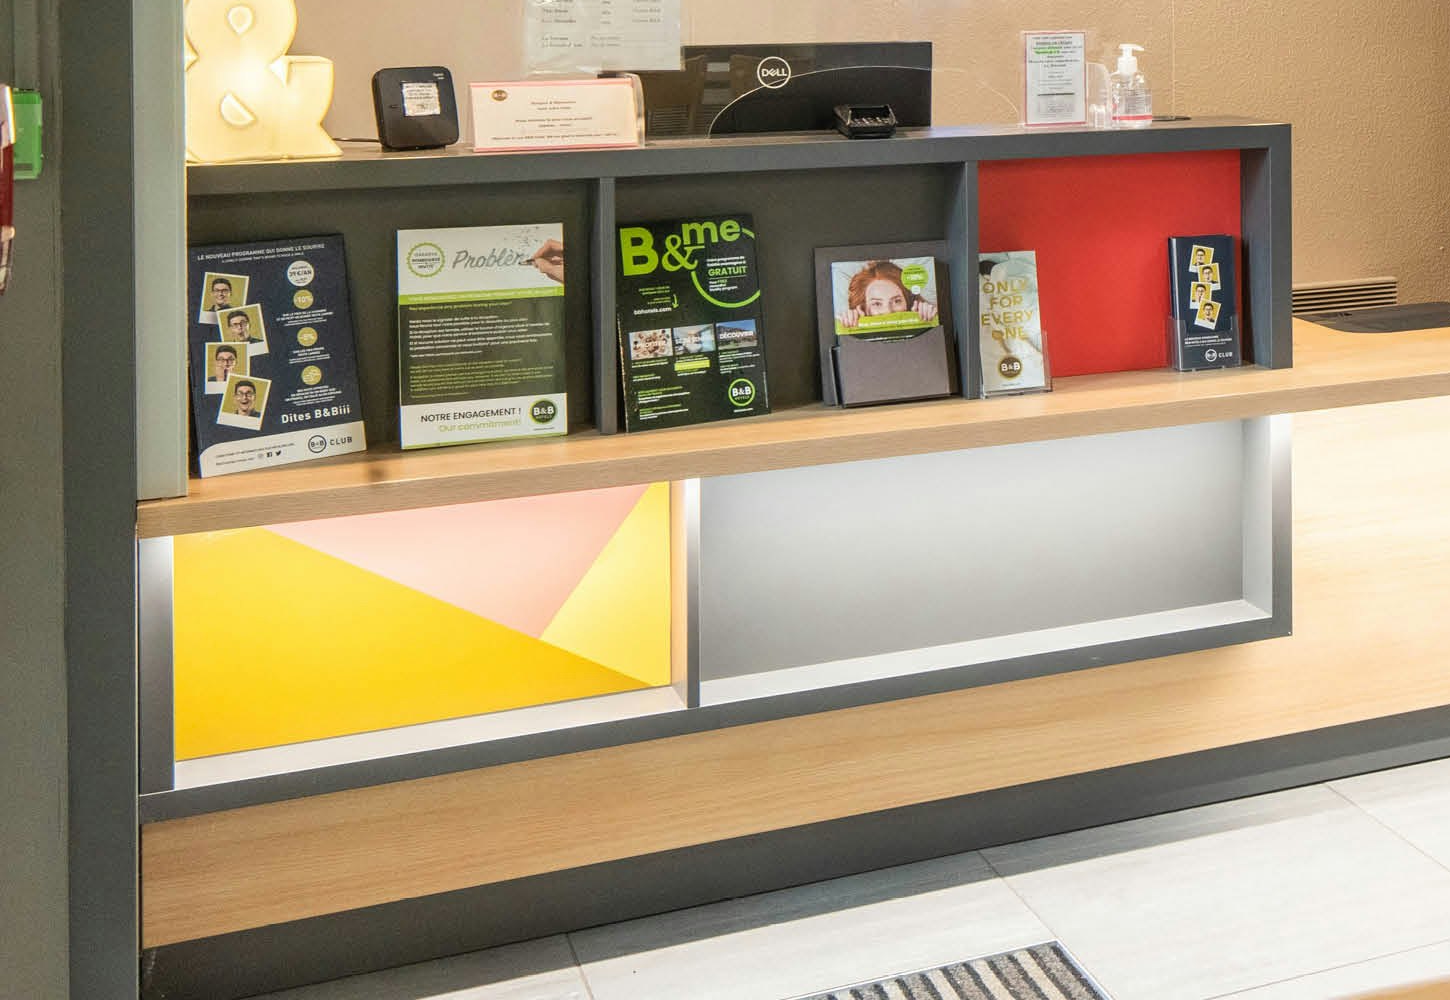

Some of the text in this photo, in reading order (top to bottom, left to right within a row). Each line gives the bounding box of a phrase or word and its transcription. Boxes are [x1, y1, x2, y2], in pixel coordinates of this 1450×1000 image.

[761, 68, 787, 77] DELL
[708, 266, 747, 276] GRATUIT
[983, 279, 1028, 294] ONLY
[990, 295, 1023, 309] FOR
[981, 311, 1033, 326] EVERY
[1001, 362, 1020, 372] B&B
[732, 386, 751, 397] B&B
[281, 405, 351, 424] Dites B&Biii
[421, 414, 451, 423] NOTRE
[453, 408, 514, 420] ENGAGEMENT
[533, 406, 554, 416] B&B
[329, 436, 353, 446] CLUB
